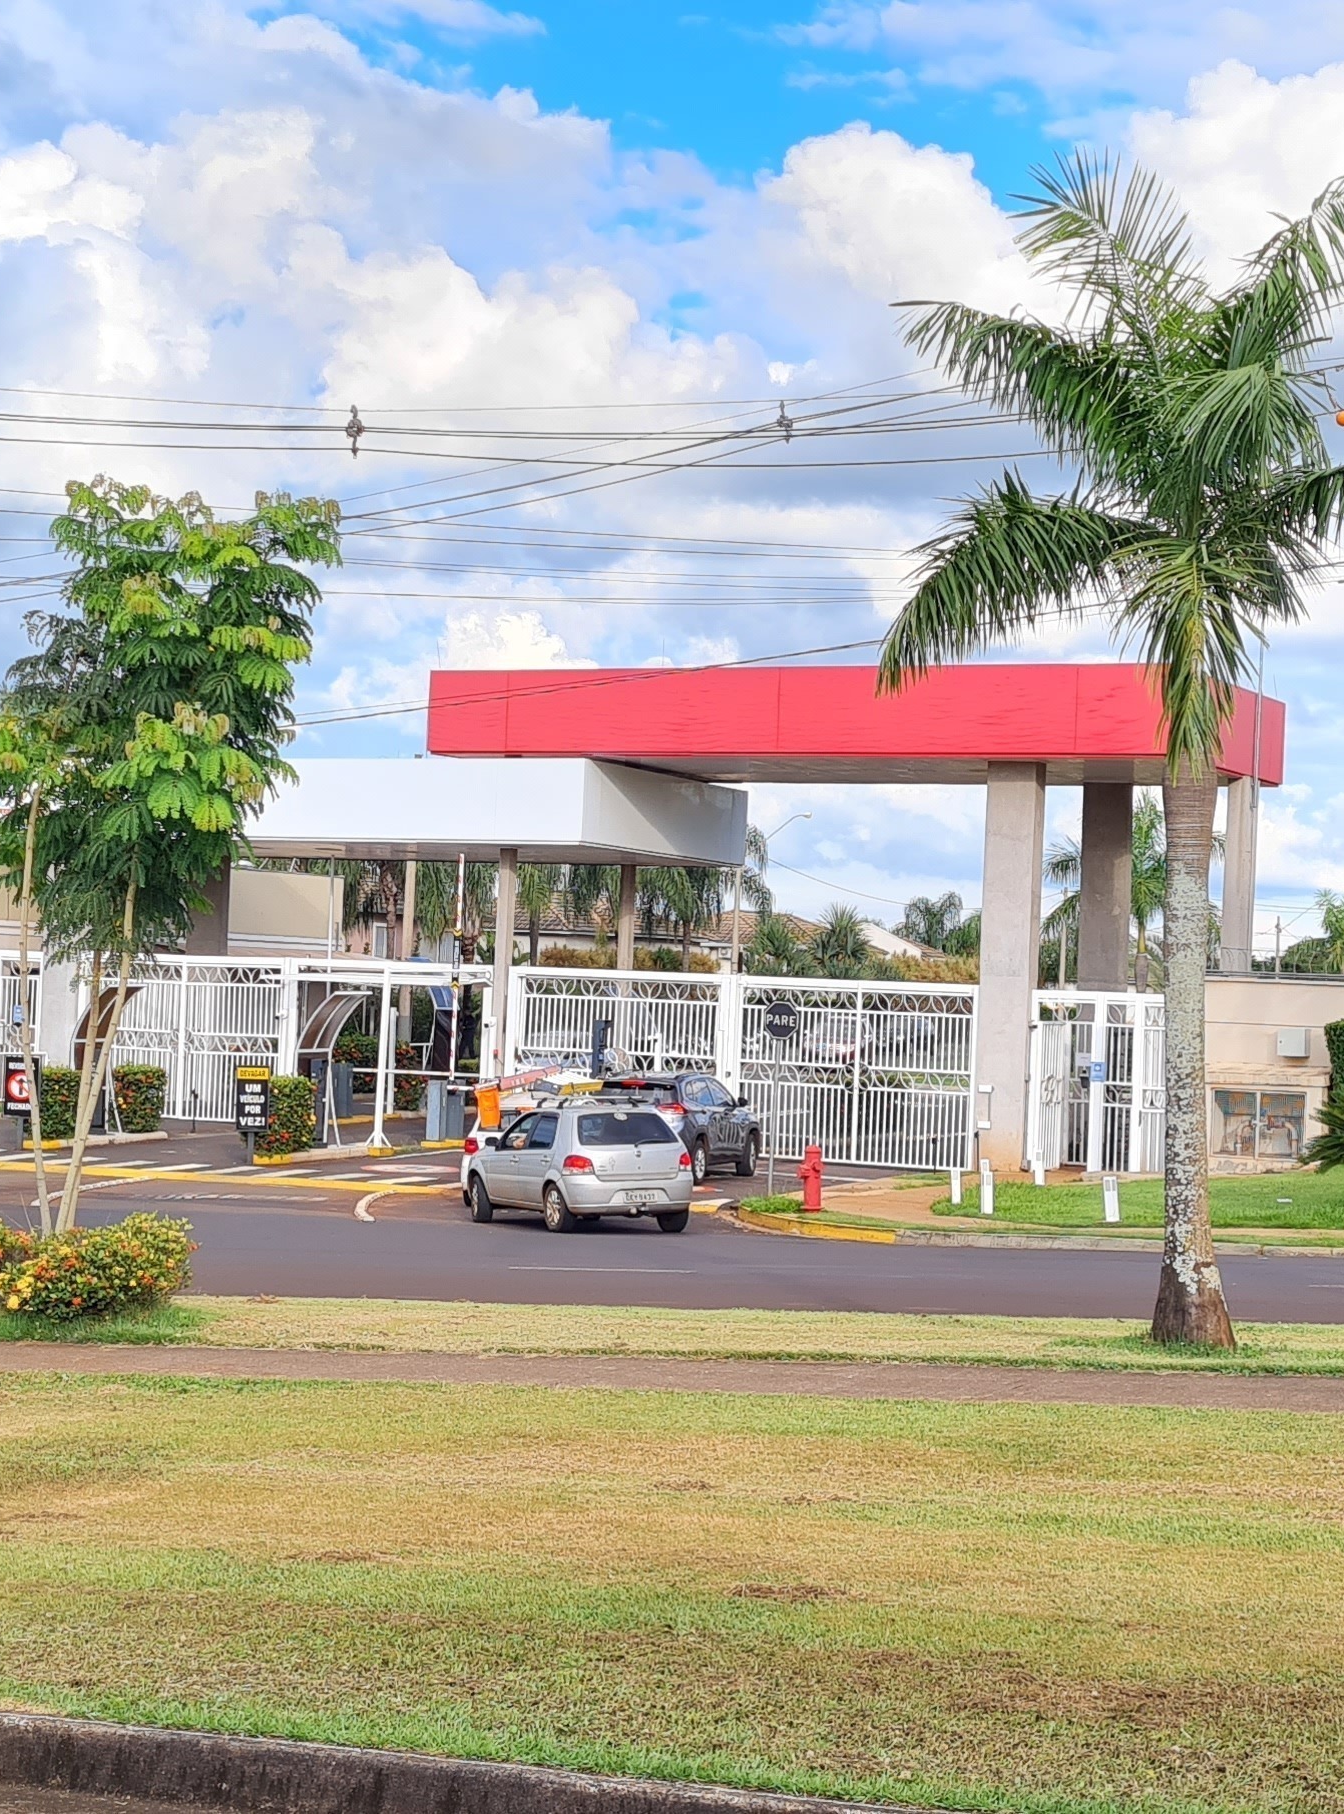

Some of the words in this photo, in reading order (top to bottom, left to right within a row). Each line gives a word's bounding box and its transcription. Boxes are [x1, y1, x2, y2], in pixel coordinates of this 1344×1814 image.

[766, 1013, 796, 1027] PARE
[245, 1084, 262, 1093] UM
[245, 1105, 262, 1114] POR
